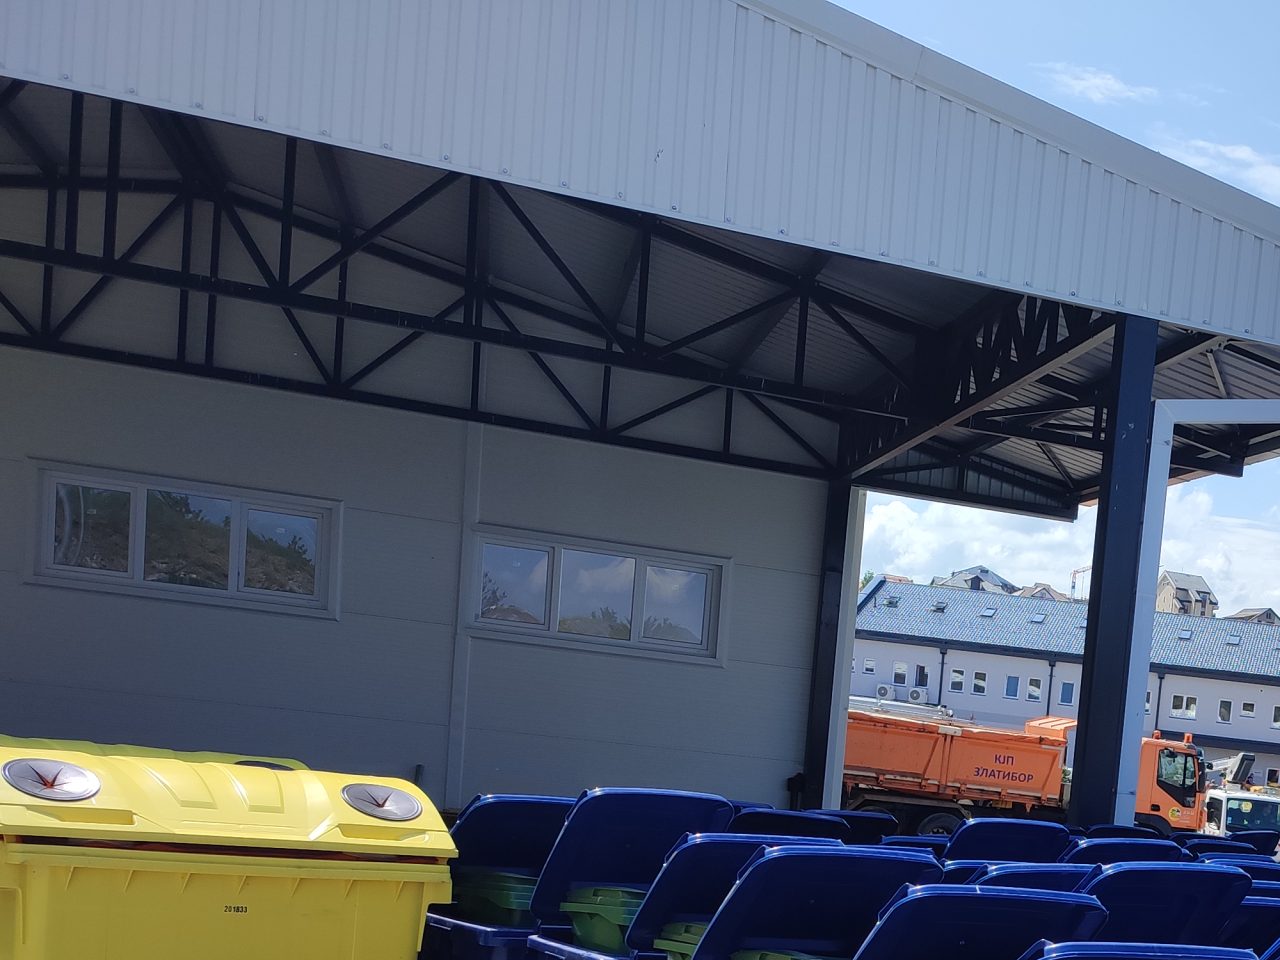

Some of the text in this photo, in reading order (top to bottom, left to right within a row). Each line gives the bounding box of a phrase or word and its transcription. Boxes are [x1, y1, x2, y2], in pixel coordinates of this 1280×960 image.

[994, 754, 1014, 766] КЈП
[973, 766, 1034, 783] ЗЛАТИБОР
[223, 905, 248, 914] 201833
